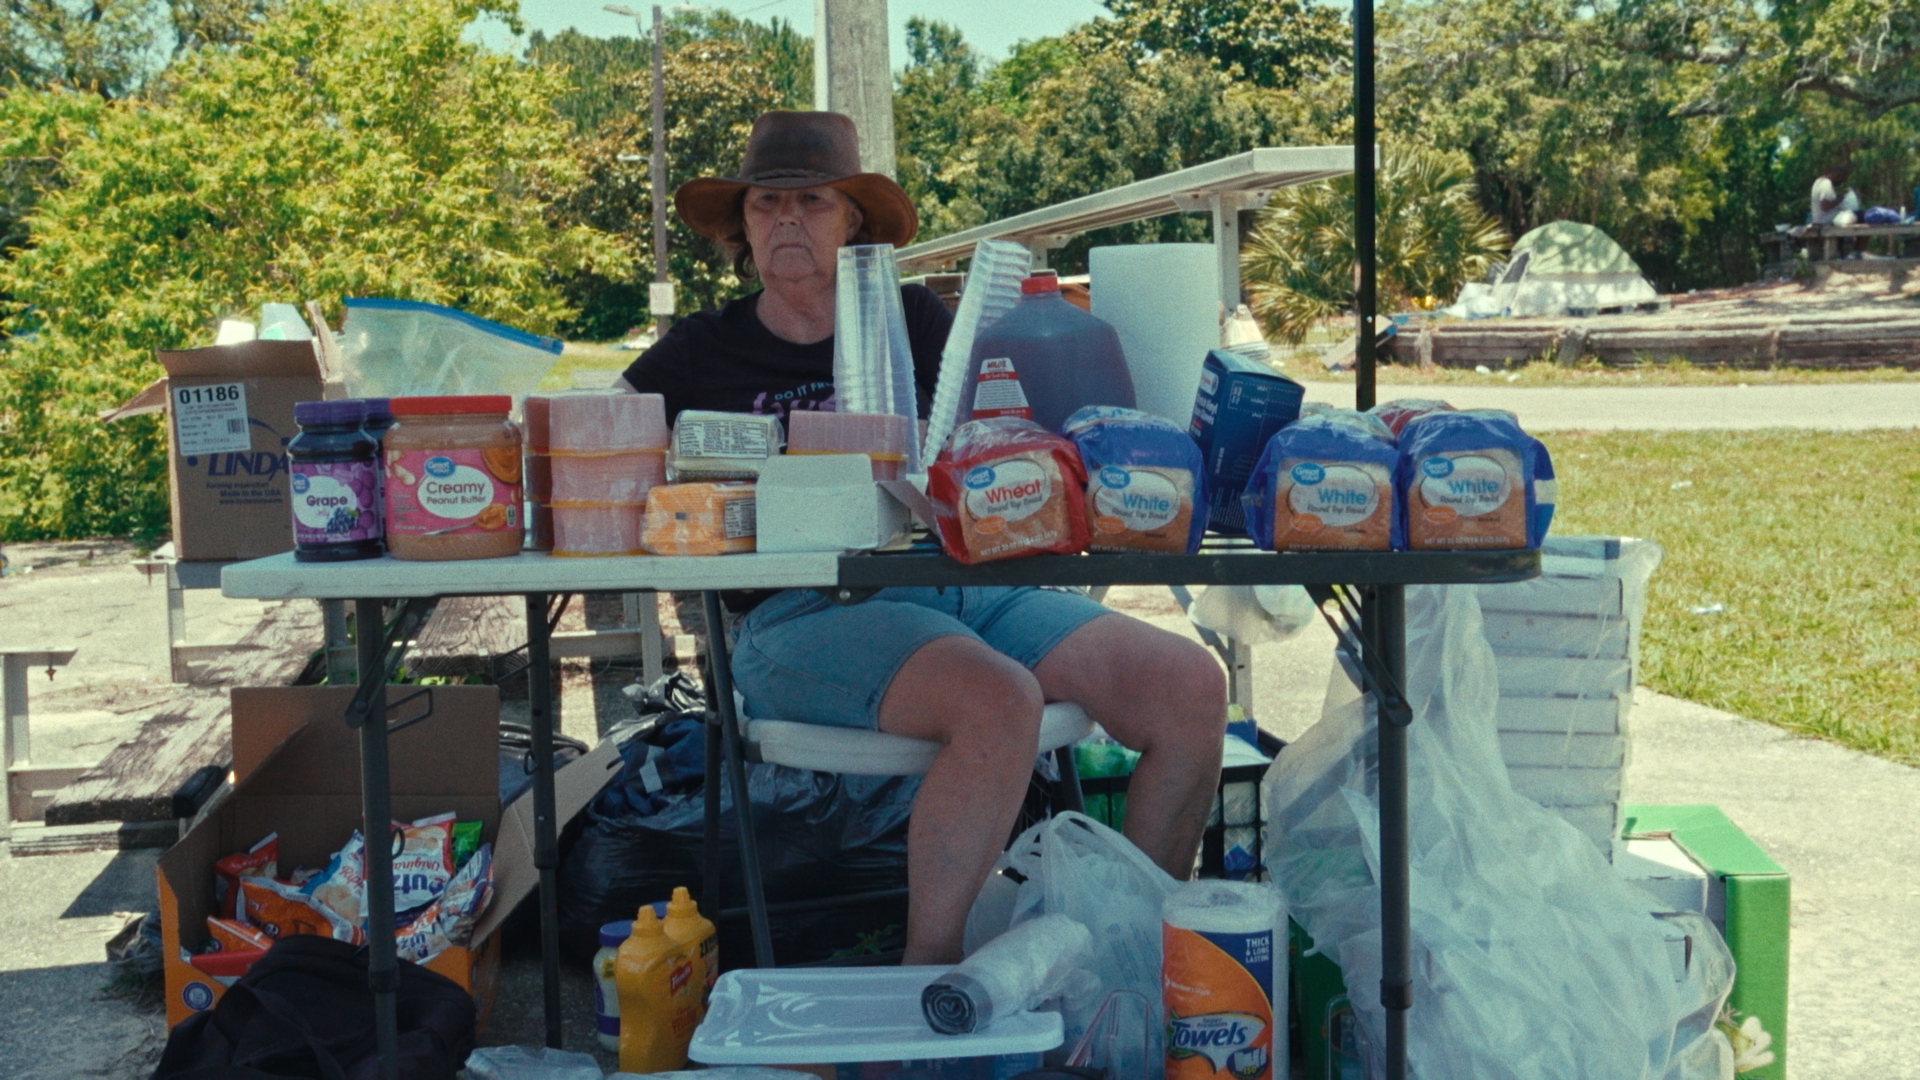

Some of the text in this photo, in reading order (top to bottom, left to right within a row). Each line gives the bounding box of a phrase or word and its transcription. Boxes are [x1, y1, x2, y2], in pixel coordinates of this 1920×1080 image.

[179, 385, 240, 404] 01186
[774, 381, 834, 401] DO IT FR
[426, 482, 486, 495] Creamy
[985, 479, 1041, 505] Wheat
[1449, 478, 1499, 494] White
[307, 495, 349, 508] Grape
[427, 496, 486, 505] Peanut Butter
[1123, 493, 1170, 512] White
[1318, 488, 1368, 506] White
[393, 856, 441, 871] Origina
[1246, 937, 1270, 948] THICK
[1246, 955, 1270, 964] LASTING
[1253, 948, 1270, 956] LONG
[1171, 1021, 1249, 1048] Towels
[1242, 1065, 1258, 1075] 150
